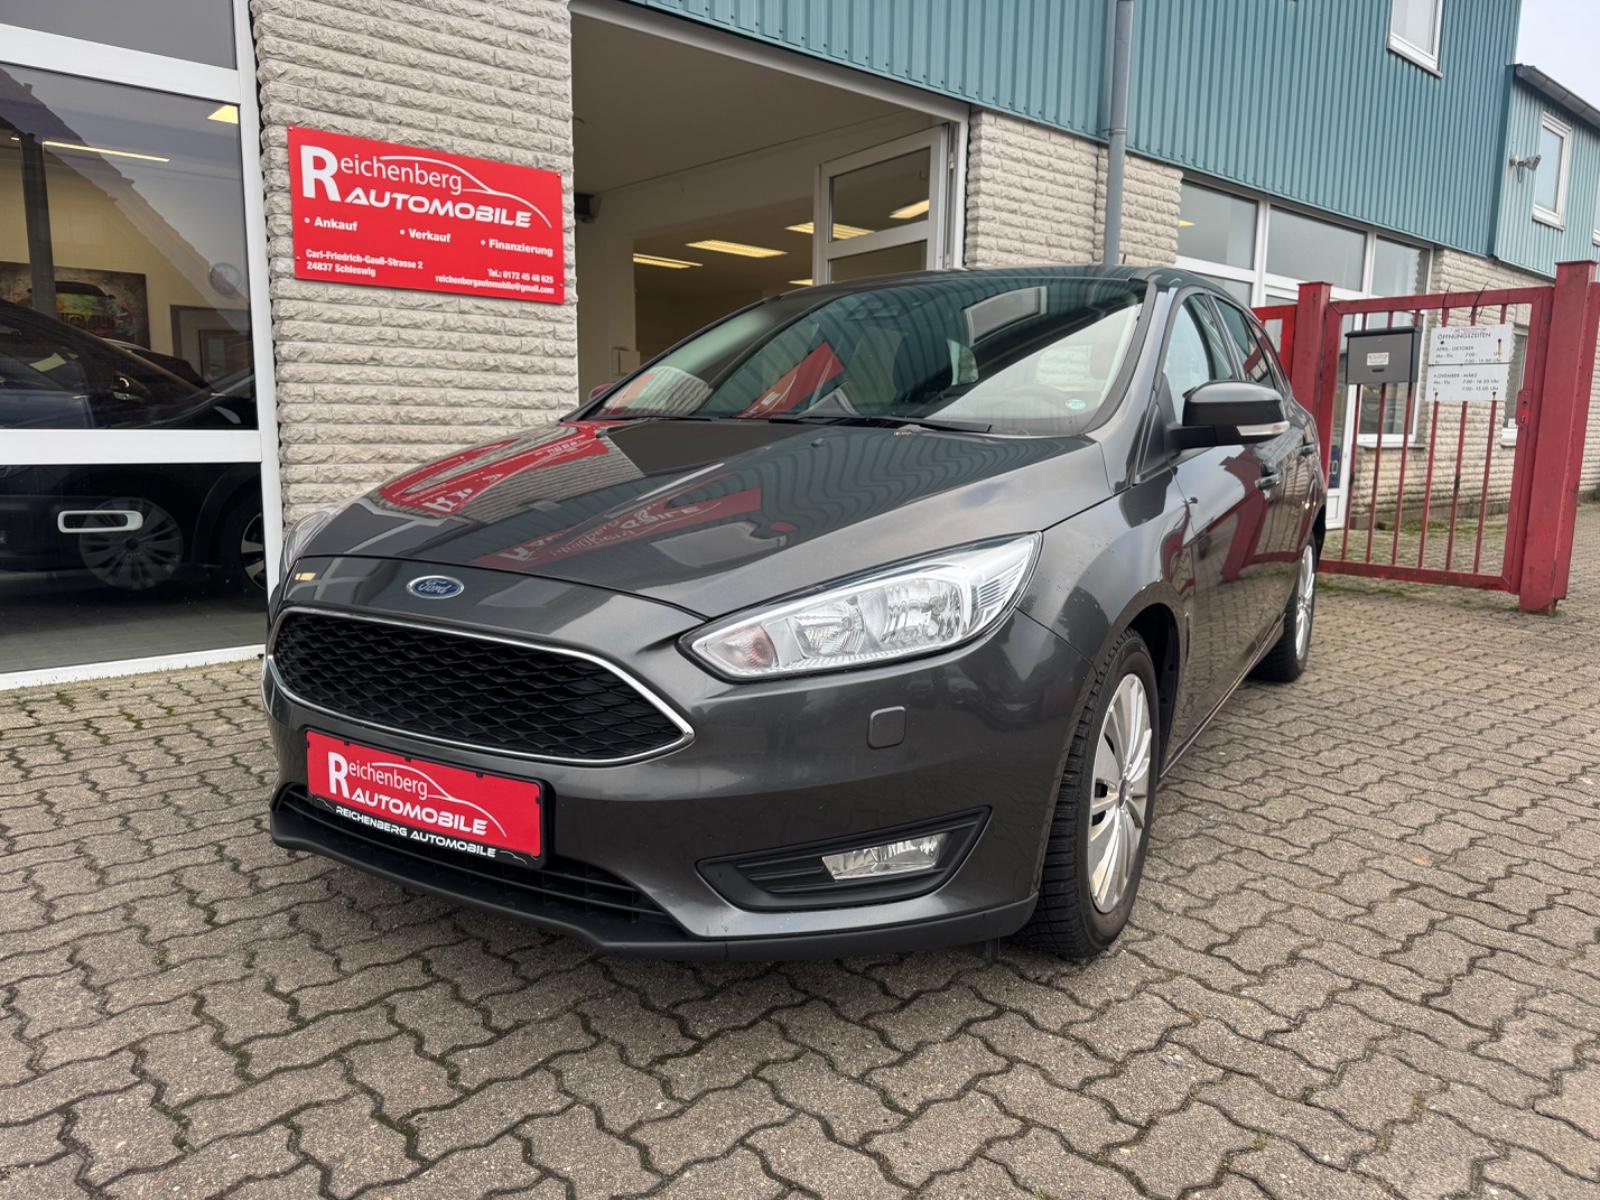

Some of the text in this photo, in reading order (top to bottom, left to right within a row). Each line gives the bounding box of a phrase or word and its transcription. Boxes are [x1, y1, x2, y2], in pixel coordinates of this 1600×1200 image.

[300, 145, 462, 201] Reichenberg
[344, 187, 532, 228] AUTOMOBILE
[314, 216, 358, 232] Ankauf
[408, 228, 451, 243] Verkauf
[489, 239, 553, 257] Finanzierung
[306, 261, 376, 277] 24837 Schleswig
[417, 260, 424, 269] 2
[503, 270, 520, 280] 0172
[418, 579, 453, 594] Ford
[327, 751, 428, 800] Reichenberg
[352, 787, 488, 836] AUTOMOBILE
[336, 805, 496, 858] REICHENBERG AUTOMOBILE
